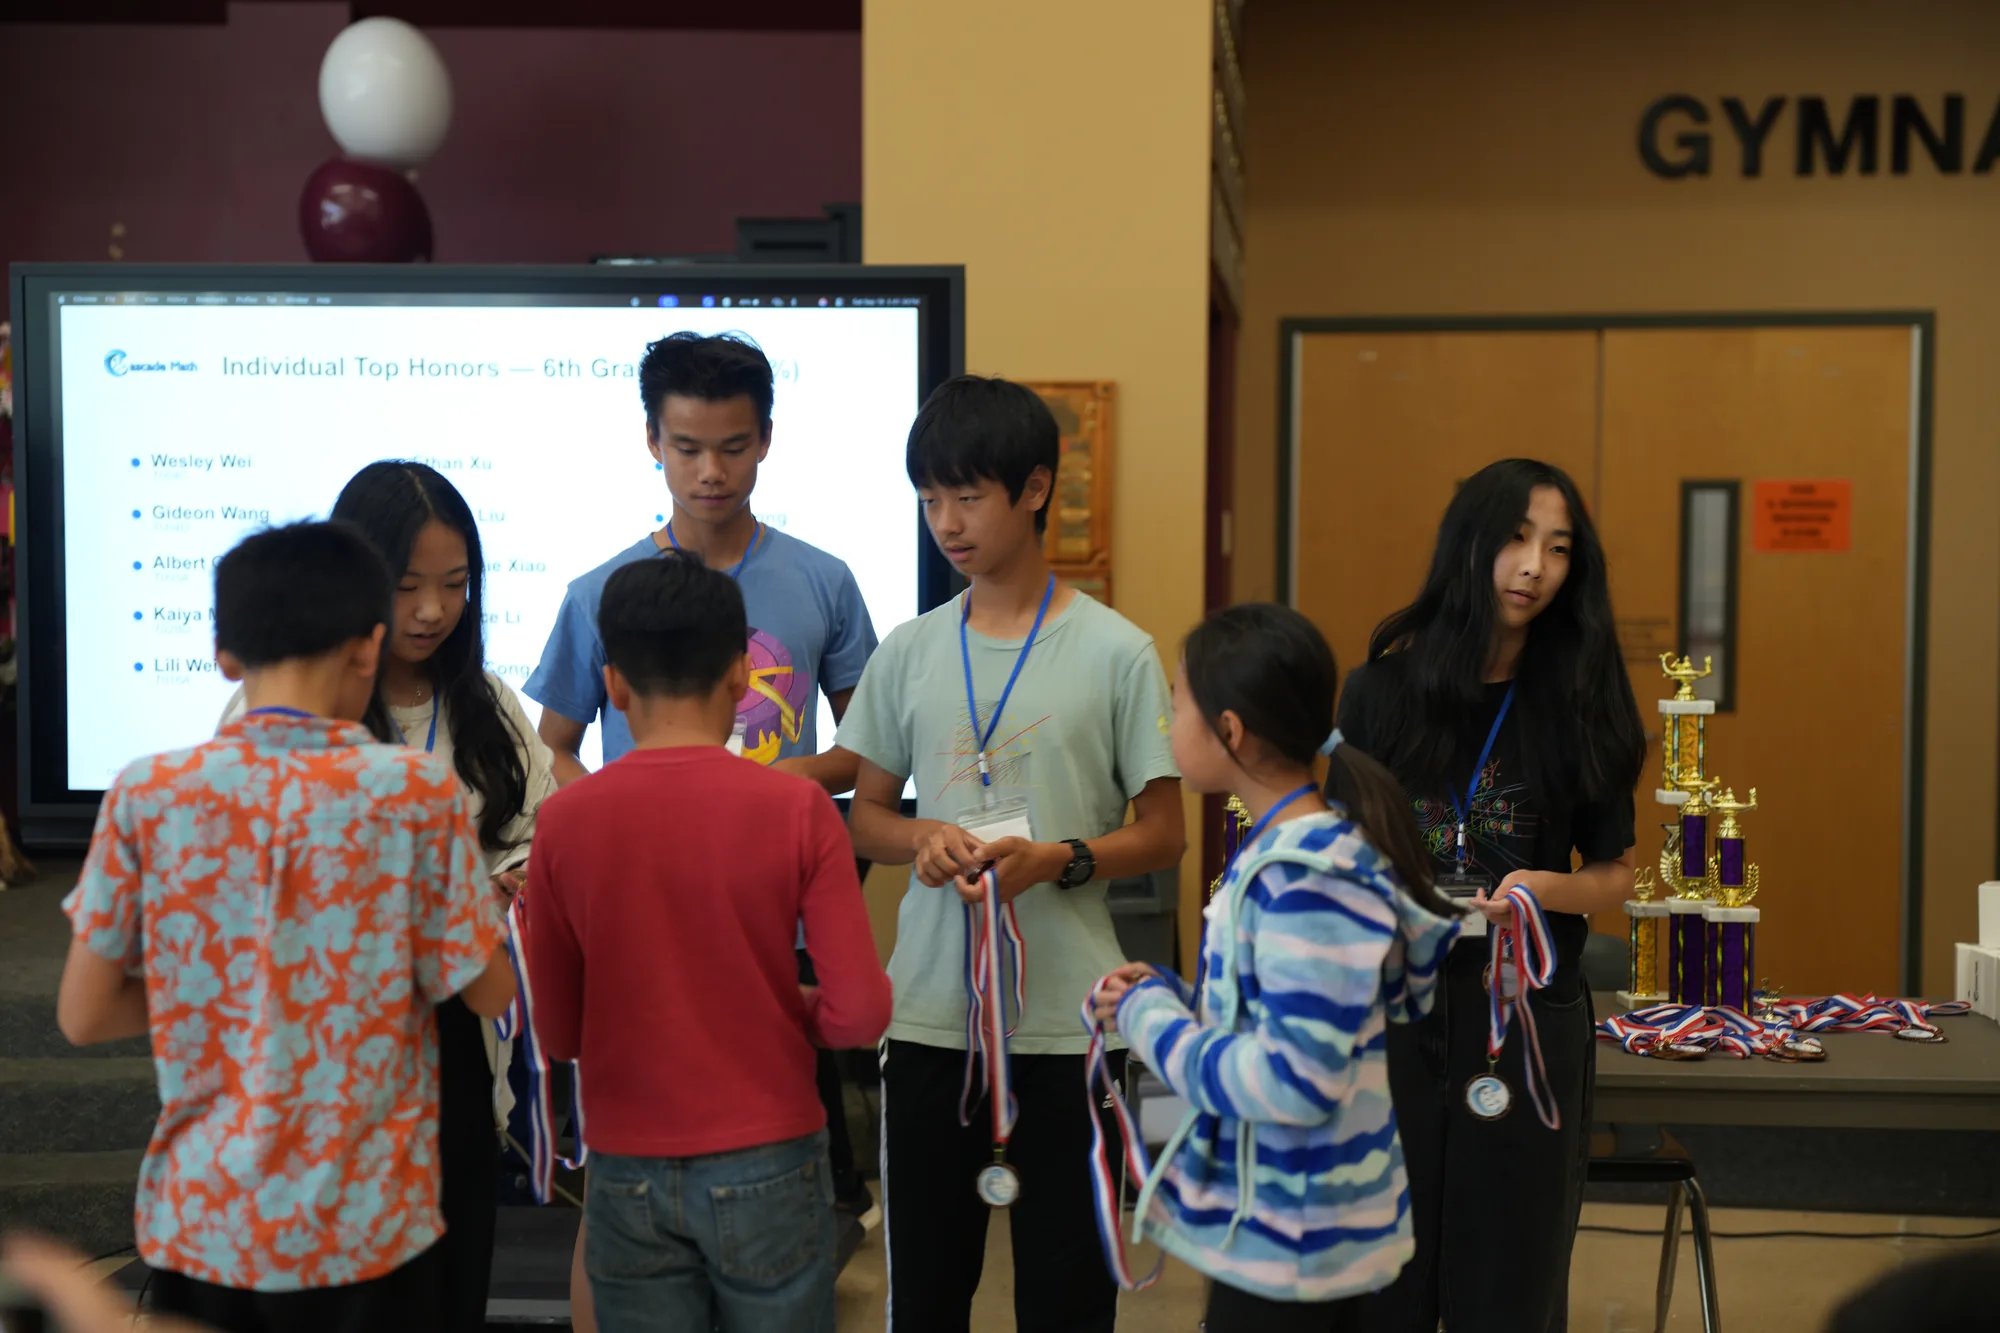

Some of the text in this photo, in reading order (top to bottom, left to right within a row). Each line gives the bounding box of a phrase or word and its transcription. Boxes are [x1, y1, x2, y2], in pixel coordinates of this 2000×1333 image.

[222, 356, 344, 377] Individual
[354, 357, 399, 381] Top
[409, 358, 499, 377] Honors
[543, 358, 581, 378] 6th
[591, 358, 642, 378] Gra
[151, 453, 252, 471] Wesley Wei
[470, 456, 492, 470] Xu
[152, 505, 270, 524] Gideon Wang
[478, 508, 505, 521] Liu
[153, 556, 205, 569] Albert
[508, 559, 547, 572] Xiao
[154, 607, 202, 626] Kaiya
[506, 609, 520, 624] Li
[154, 658, 180, 672] Lili
